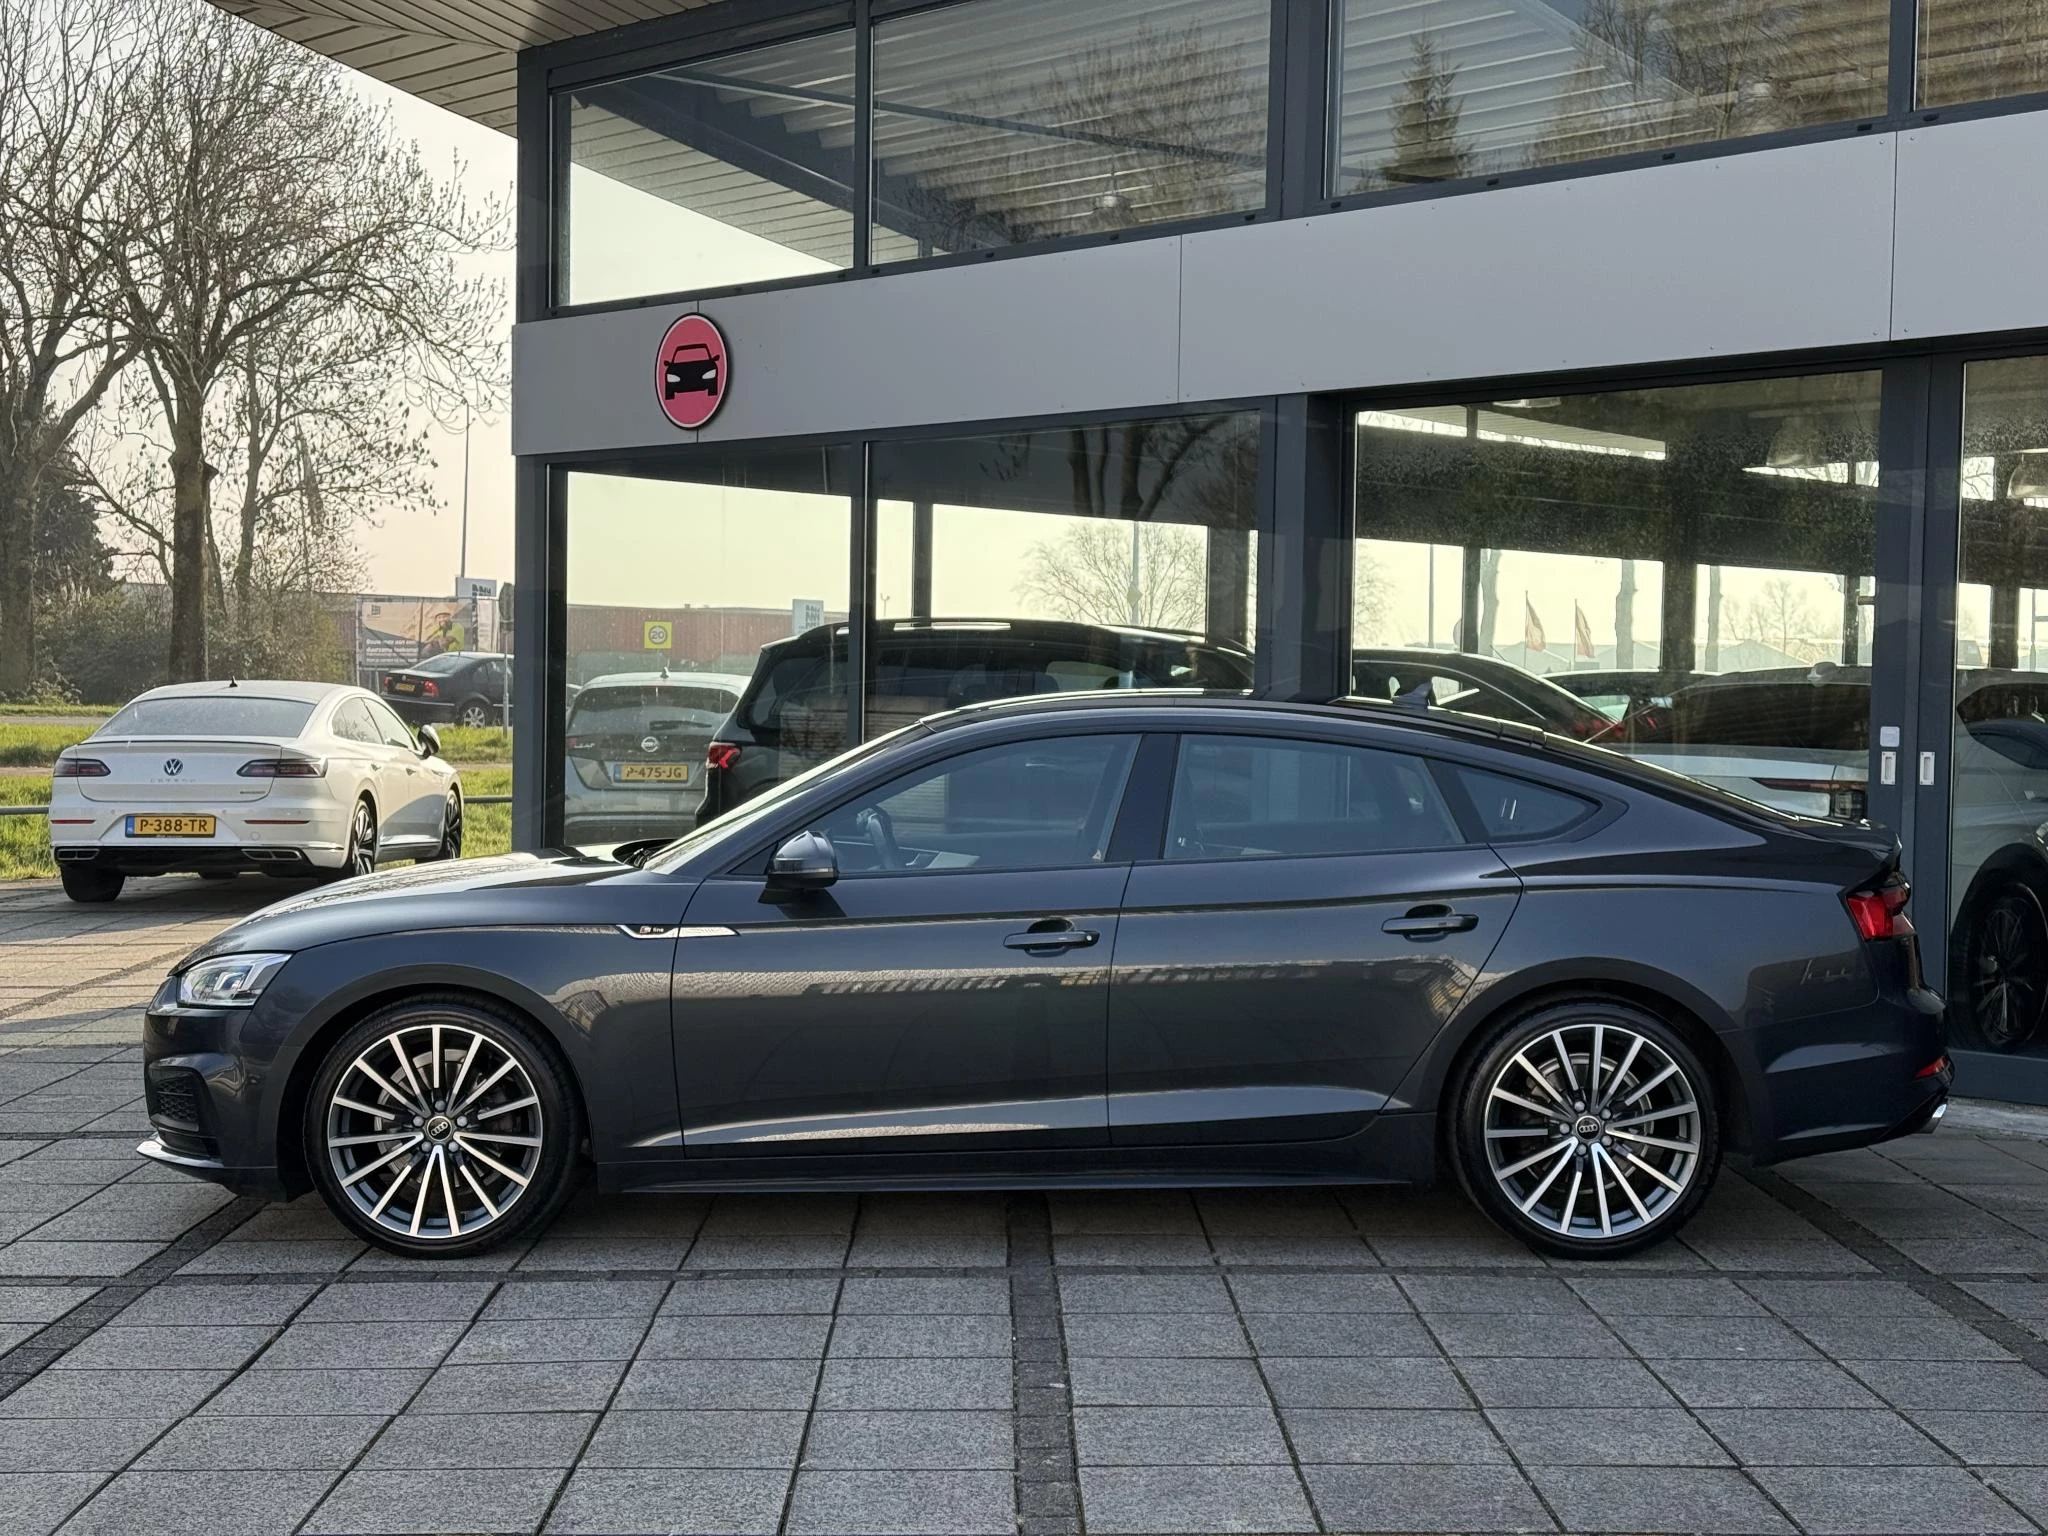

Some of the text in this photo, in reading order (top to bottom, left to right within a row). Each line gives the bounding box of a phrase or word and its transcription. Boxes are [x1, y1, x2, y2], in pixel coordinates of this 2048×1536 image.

[651, 630, 665, 640] 20
[626, 767, 682, 778] P-475-JG
[139, 819, 208, 832] P-388-TR
